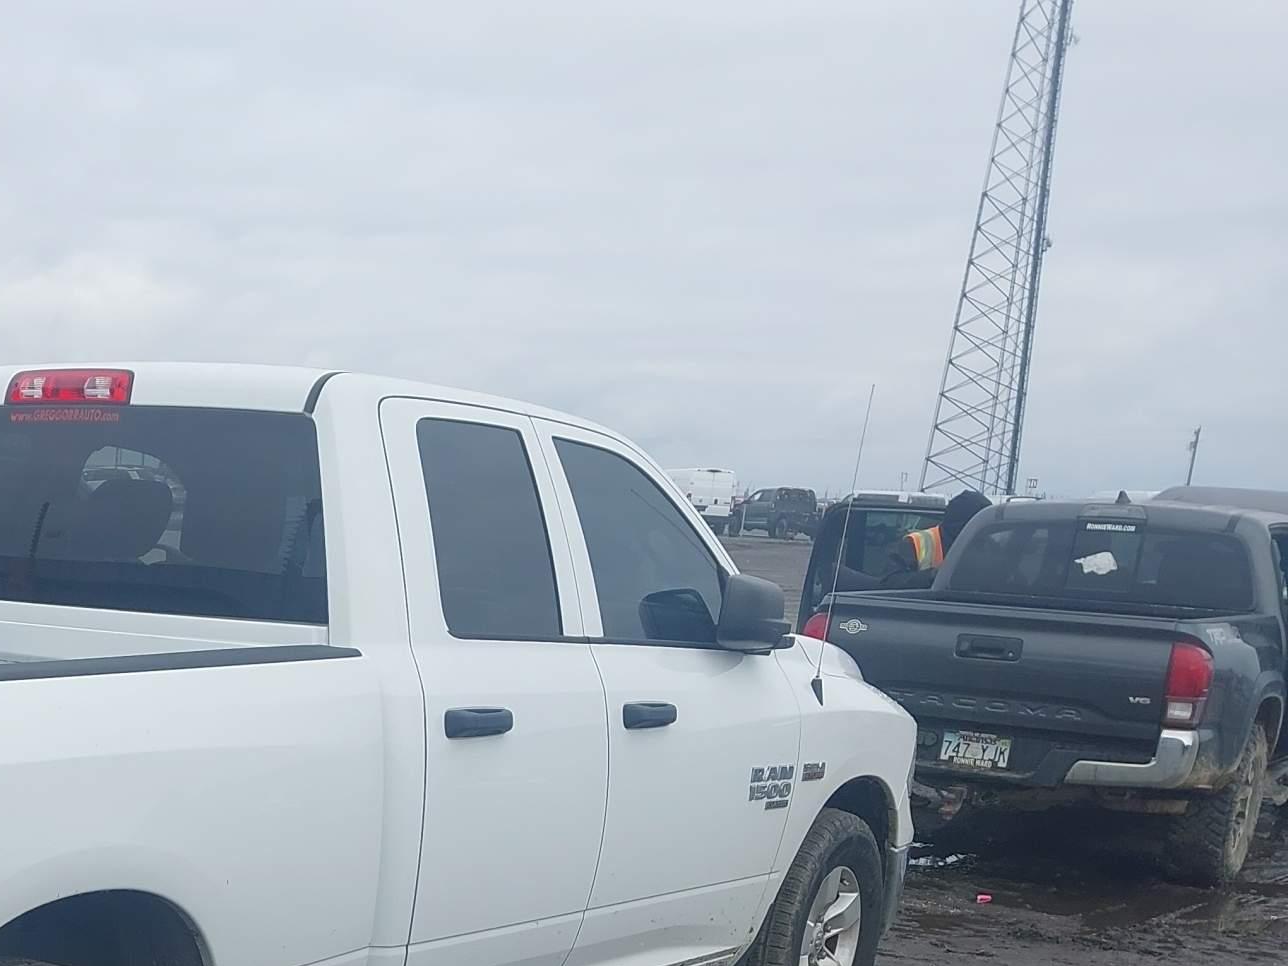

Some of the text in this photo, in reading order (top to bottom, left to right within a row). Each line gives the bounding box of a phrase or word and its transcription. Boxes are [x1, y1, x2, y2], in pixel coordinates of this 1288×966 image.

[1128, 696, 1152, 705] V6
[943, 740, 971, 759] 747
[750, 766, 794, 783] RAM
[748, 782, 792, 801] 1500
